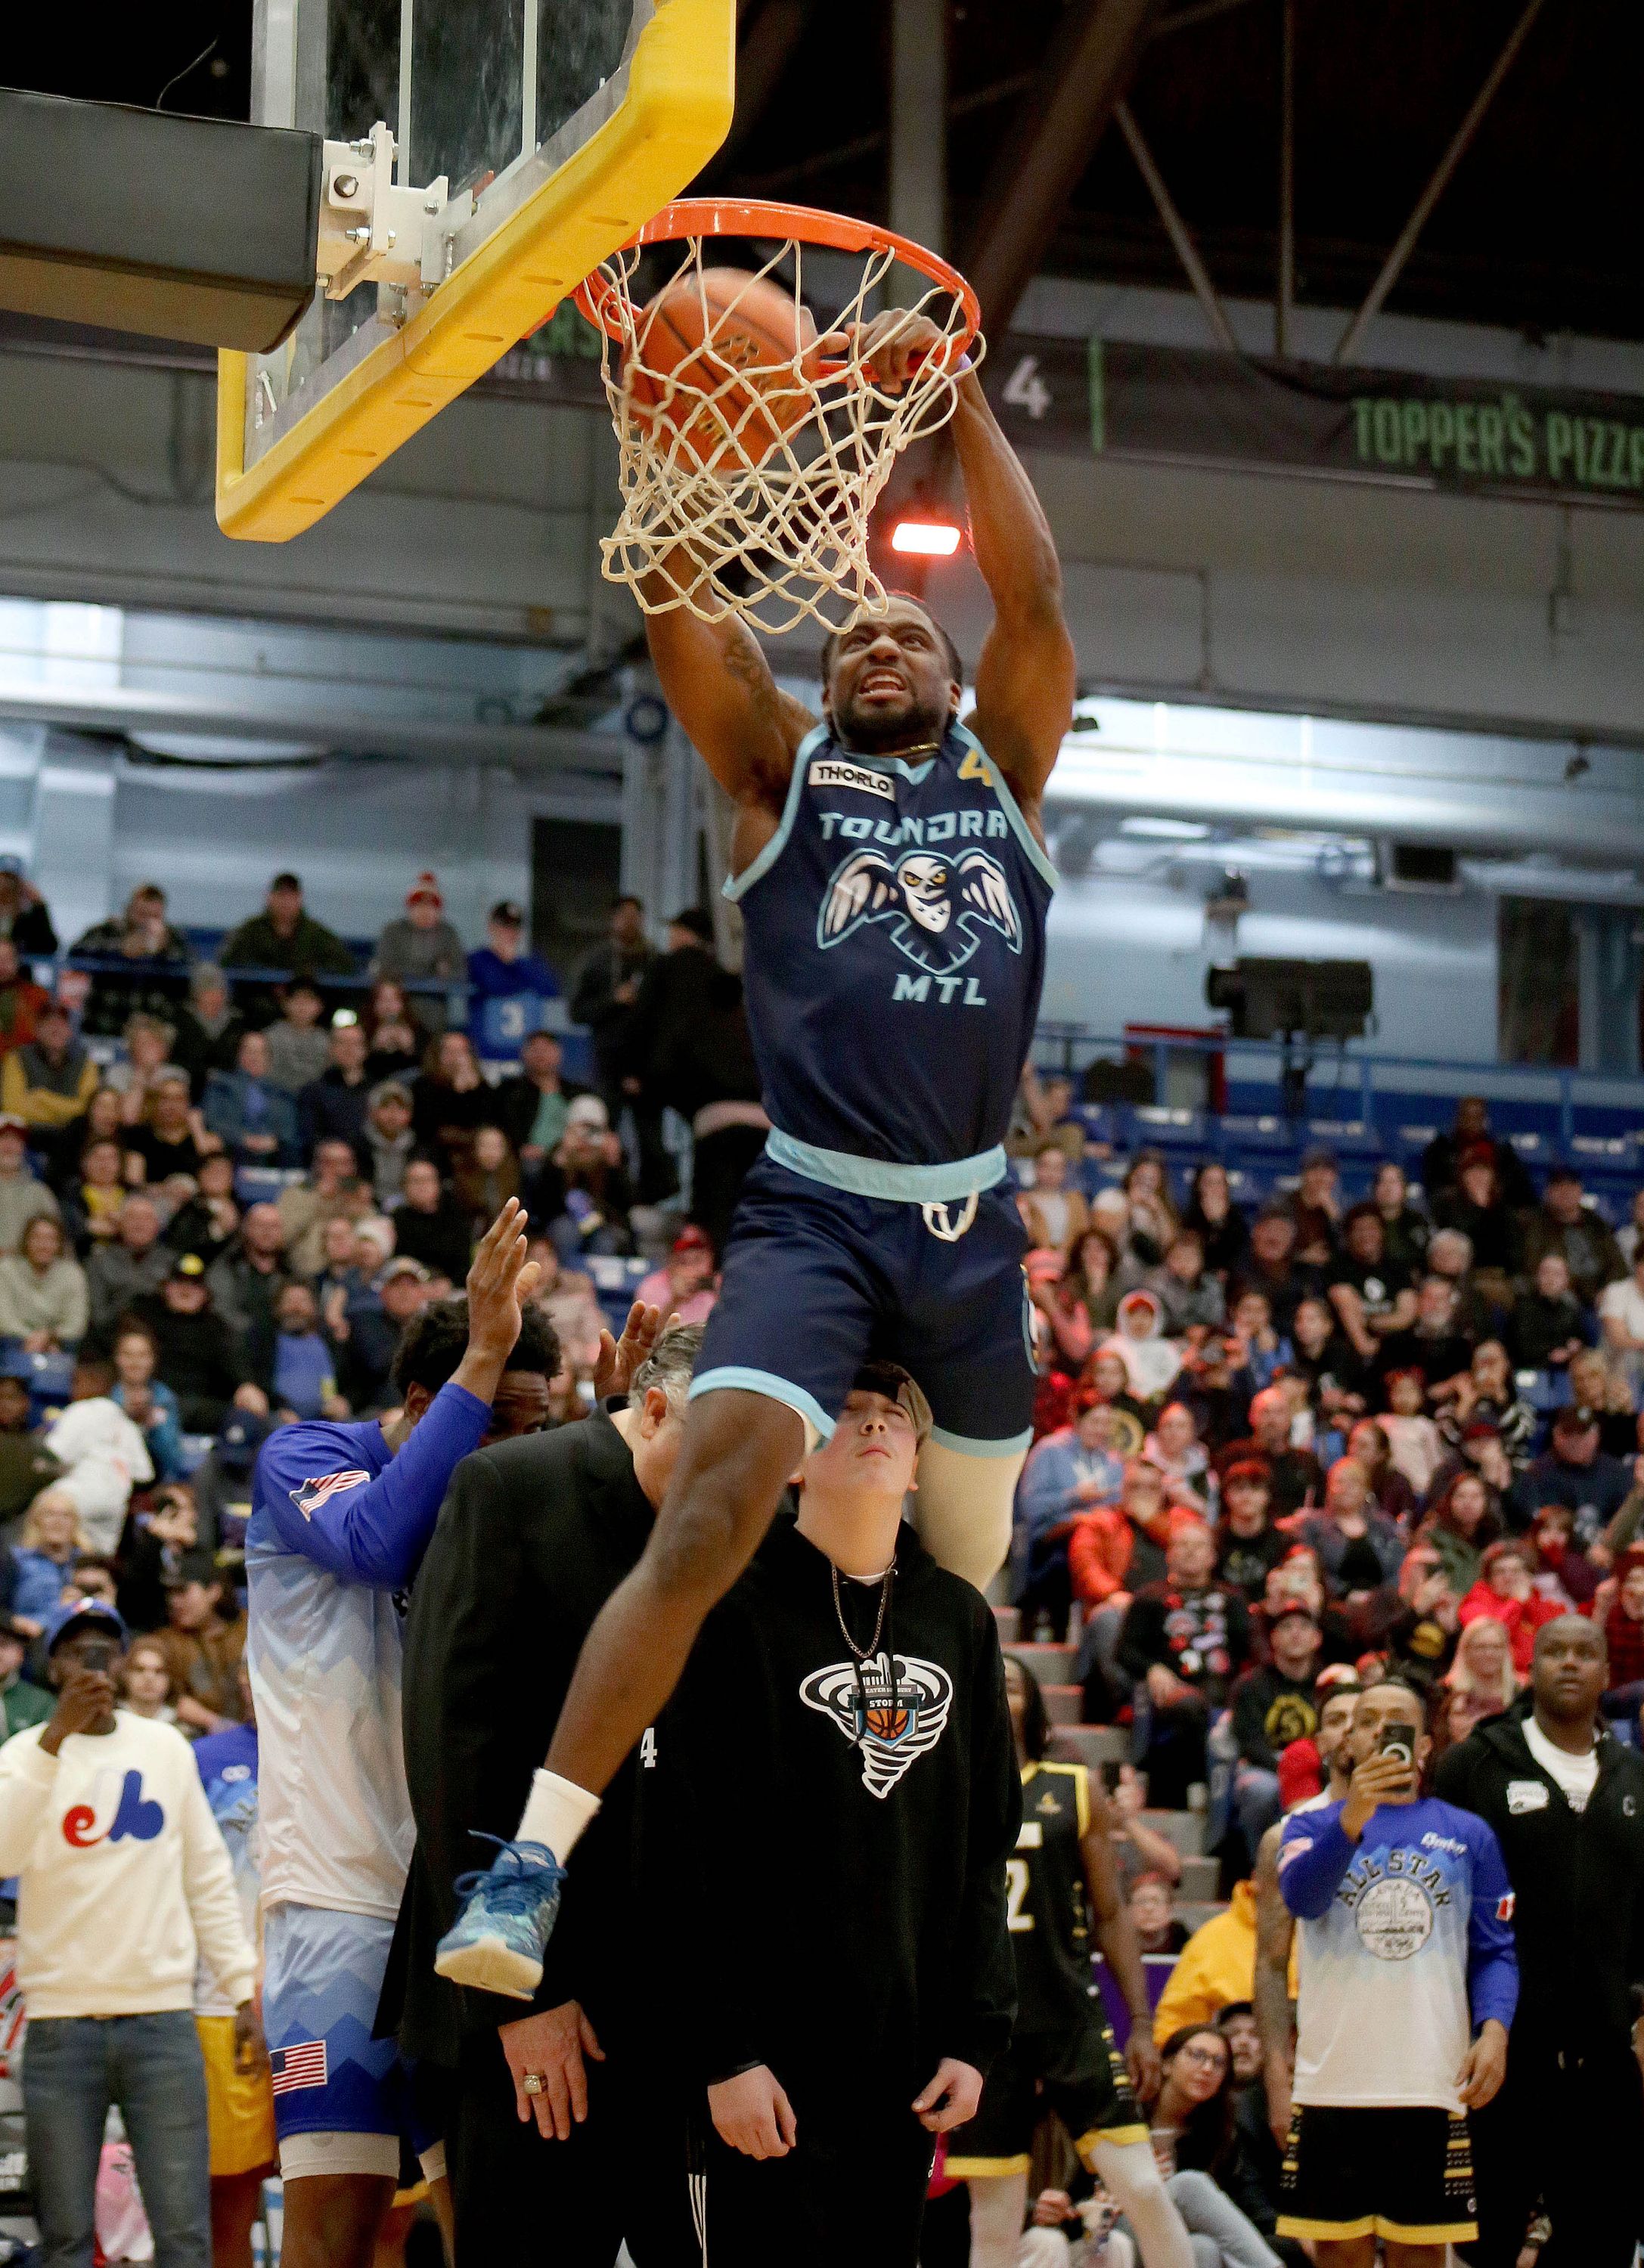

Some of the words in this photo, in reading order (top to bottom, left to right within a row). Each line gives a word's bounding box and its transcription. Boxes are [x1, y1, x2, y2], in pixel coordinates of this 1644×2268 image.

[1002, 355, 1052, 418] 4
[1352, 392, 1535, 477] TOPPER'S
[817, 765, 889, 792] THORLO
[957, 749, 993, 787] 4
[818, 809, 1008, 846] TOUNDRA
[892, 973, 987, 1005] MTL
[640, 1727, 658, 1768] 4
[1005, 1857, 1036, 1932] 2
